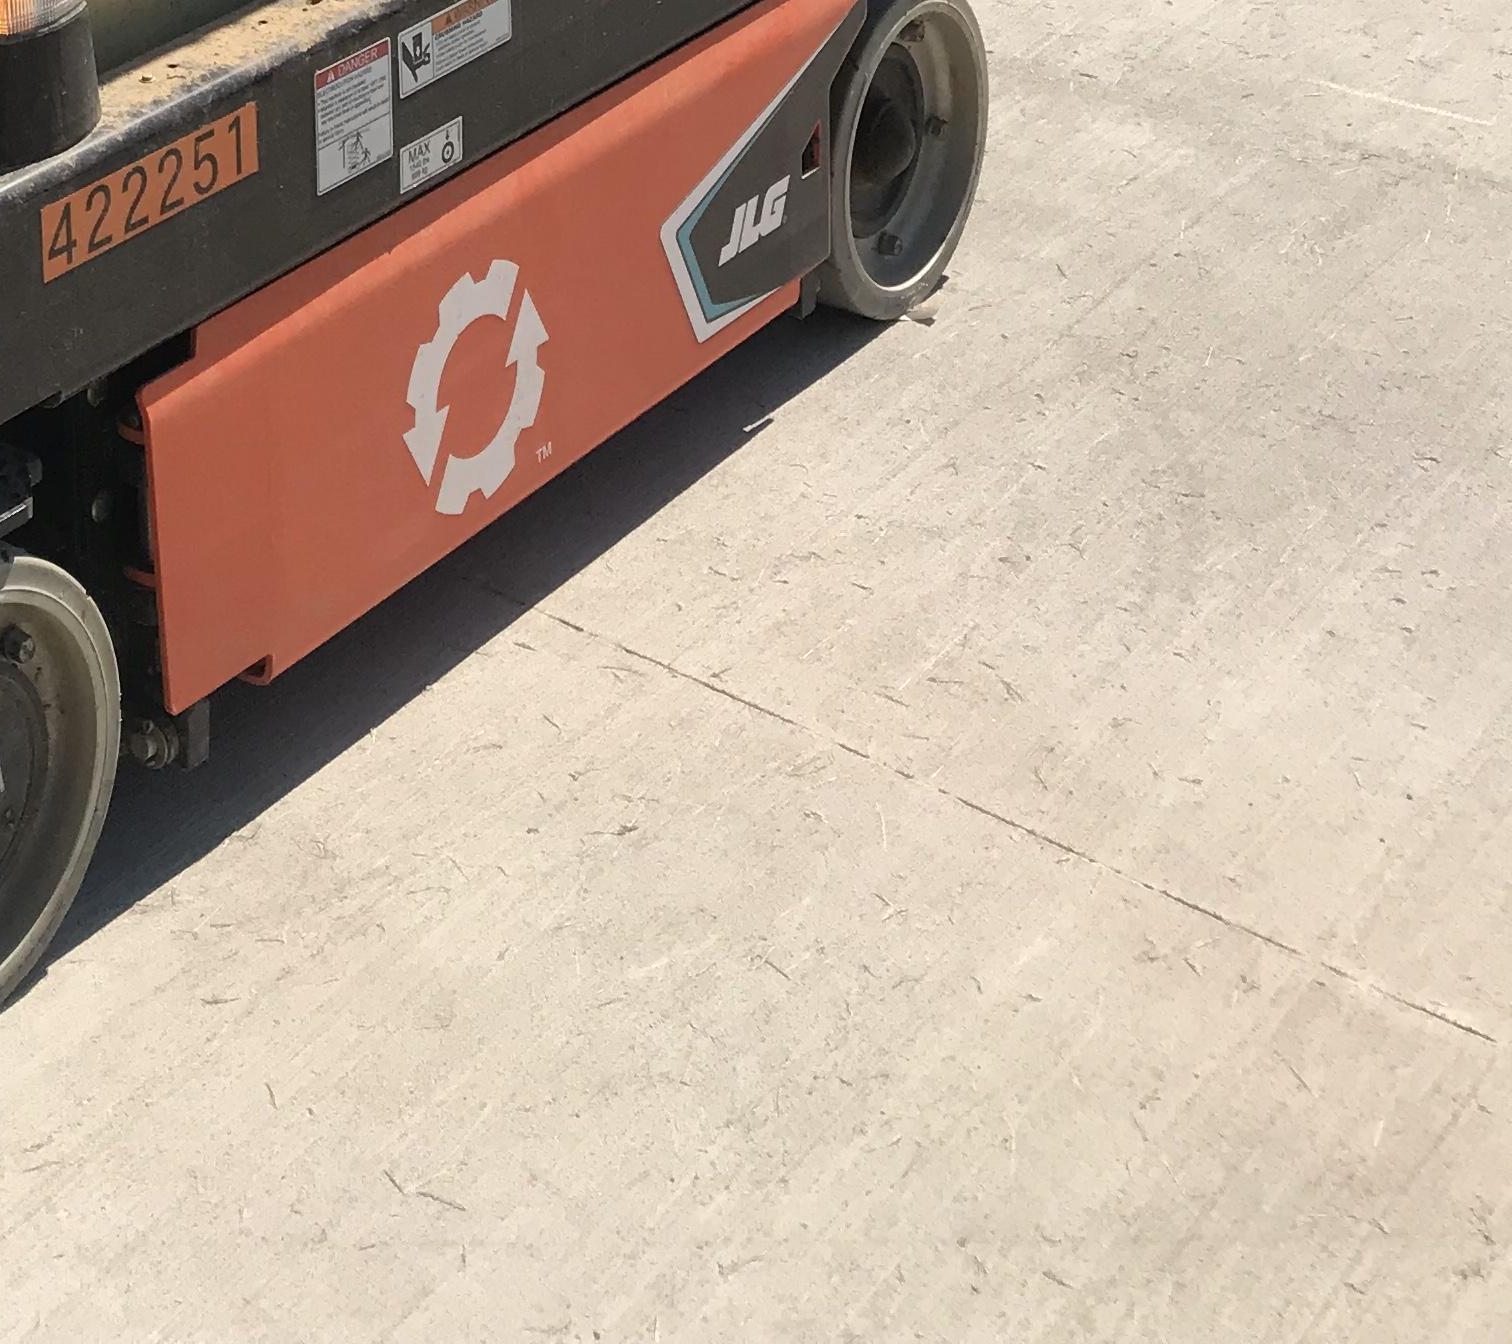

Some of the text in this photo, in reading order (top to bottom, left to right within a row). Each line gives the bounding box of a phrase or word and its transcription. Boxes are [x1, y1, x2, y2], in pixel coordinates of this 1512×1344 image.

[337, 47, 379, 77] DANGER
[408, 140, 431, 164] MAX
[47, 114, 243, 265] 422251
[718, 173, 791, 268] JLG
